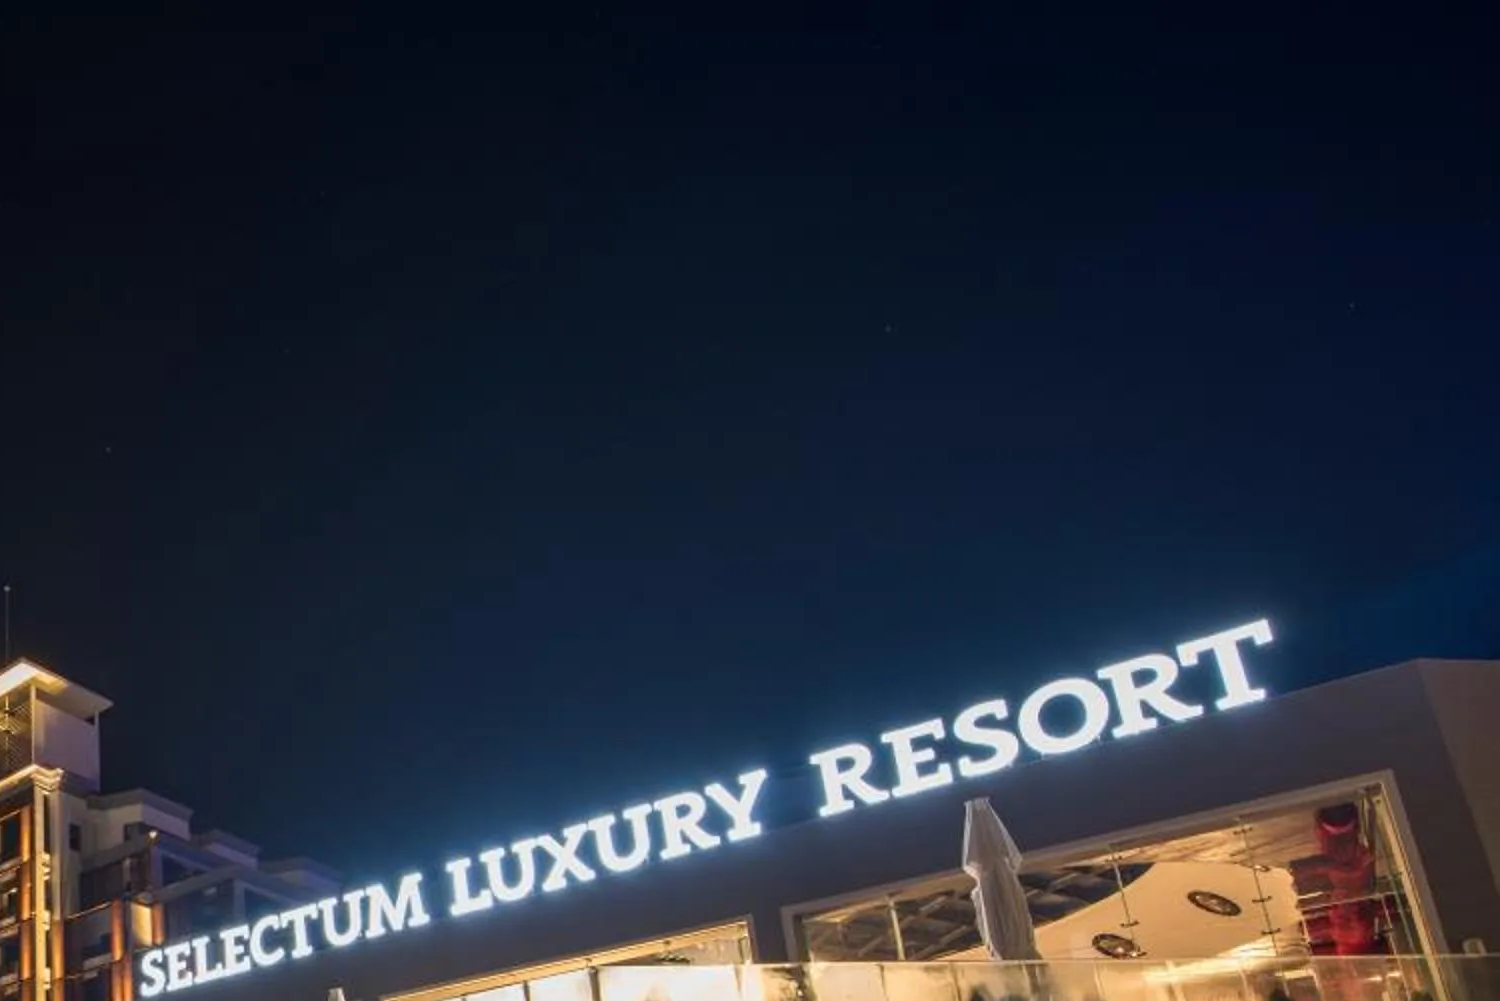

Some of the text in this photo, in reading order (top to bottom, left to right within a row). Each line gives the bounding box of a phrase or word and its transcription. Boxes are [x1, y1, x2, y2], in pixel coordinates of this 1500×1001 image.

[139, 617, 1274, 997] SELECTUM LUXURY RESORT
